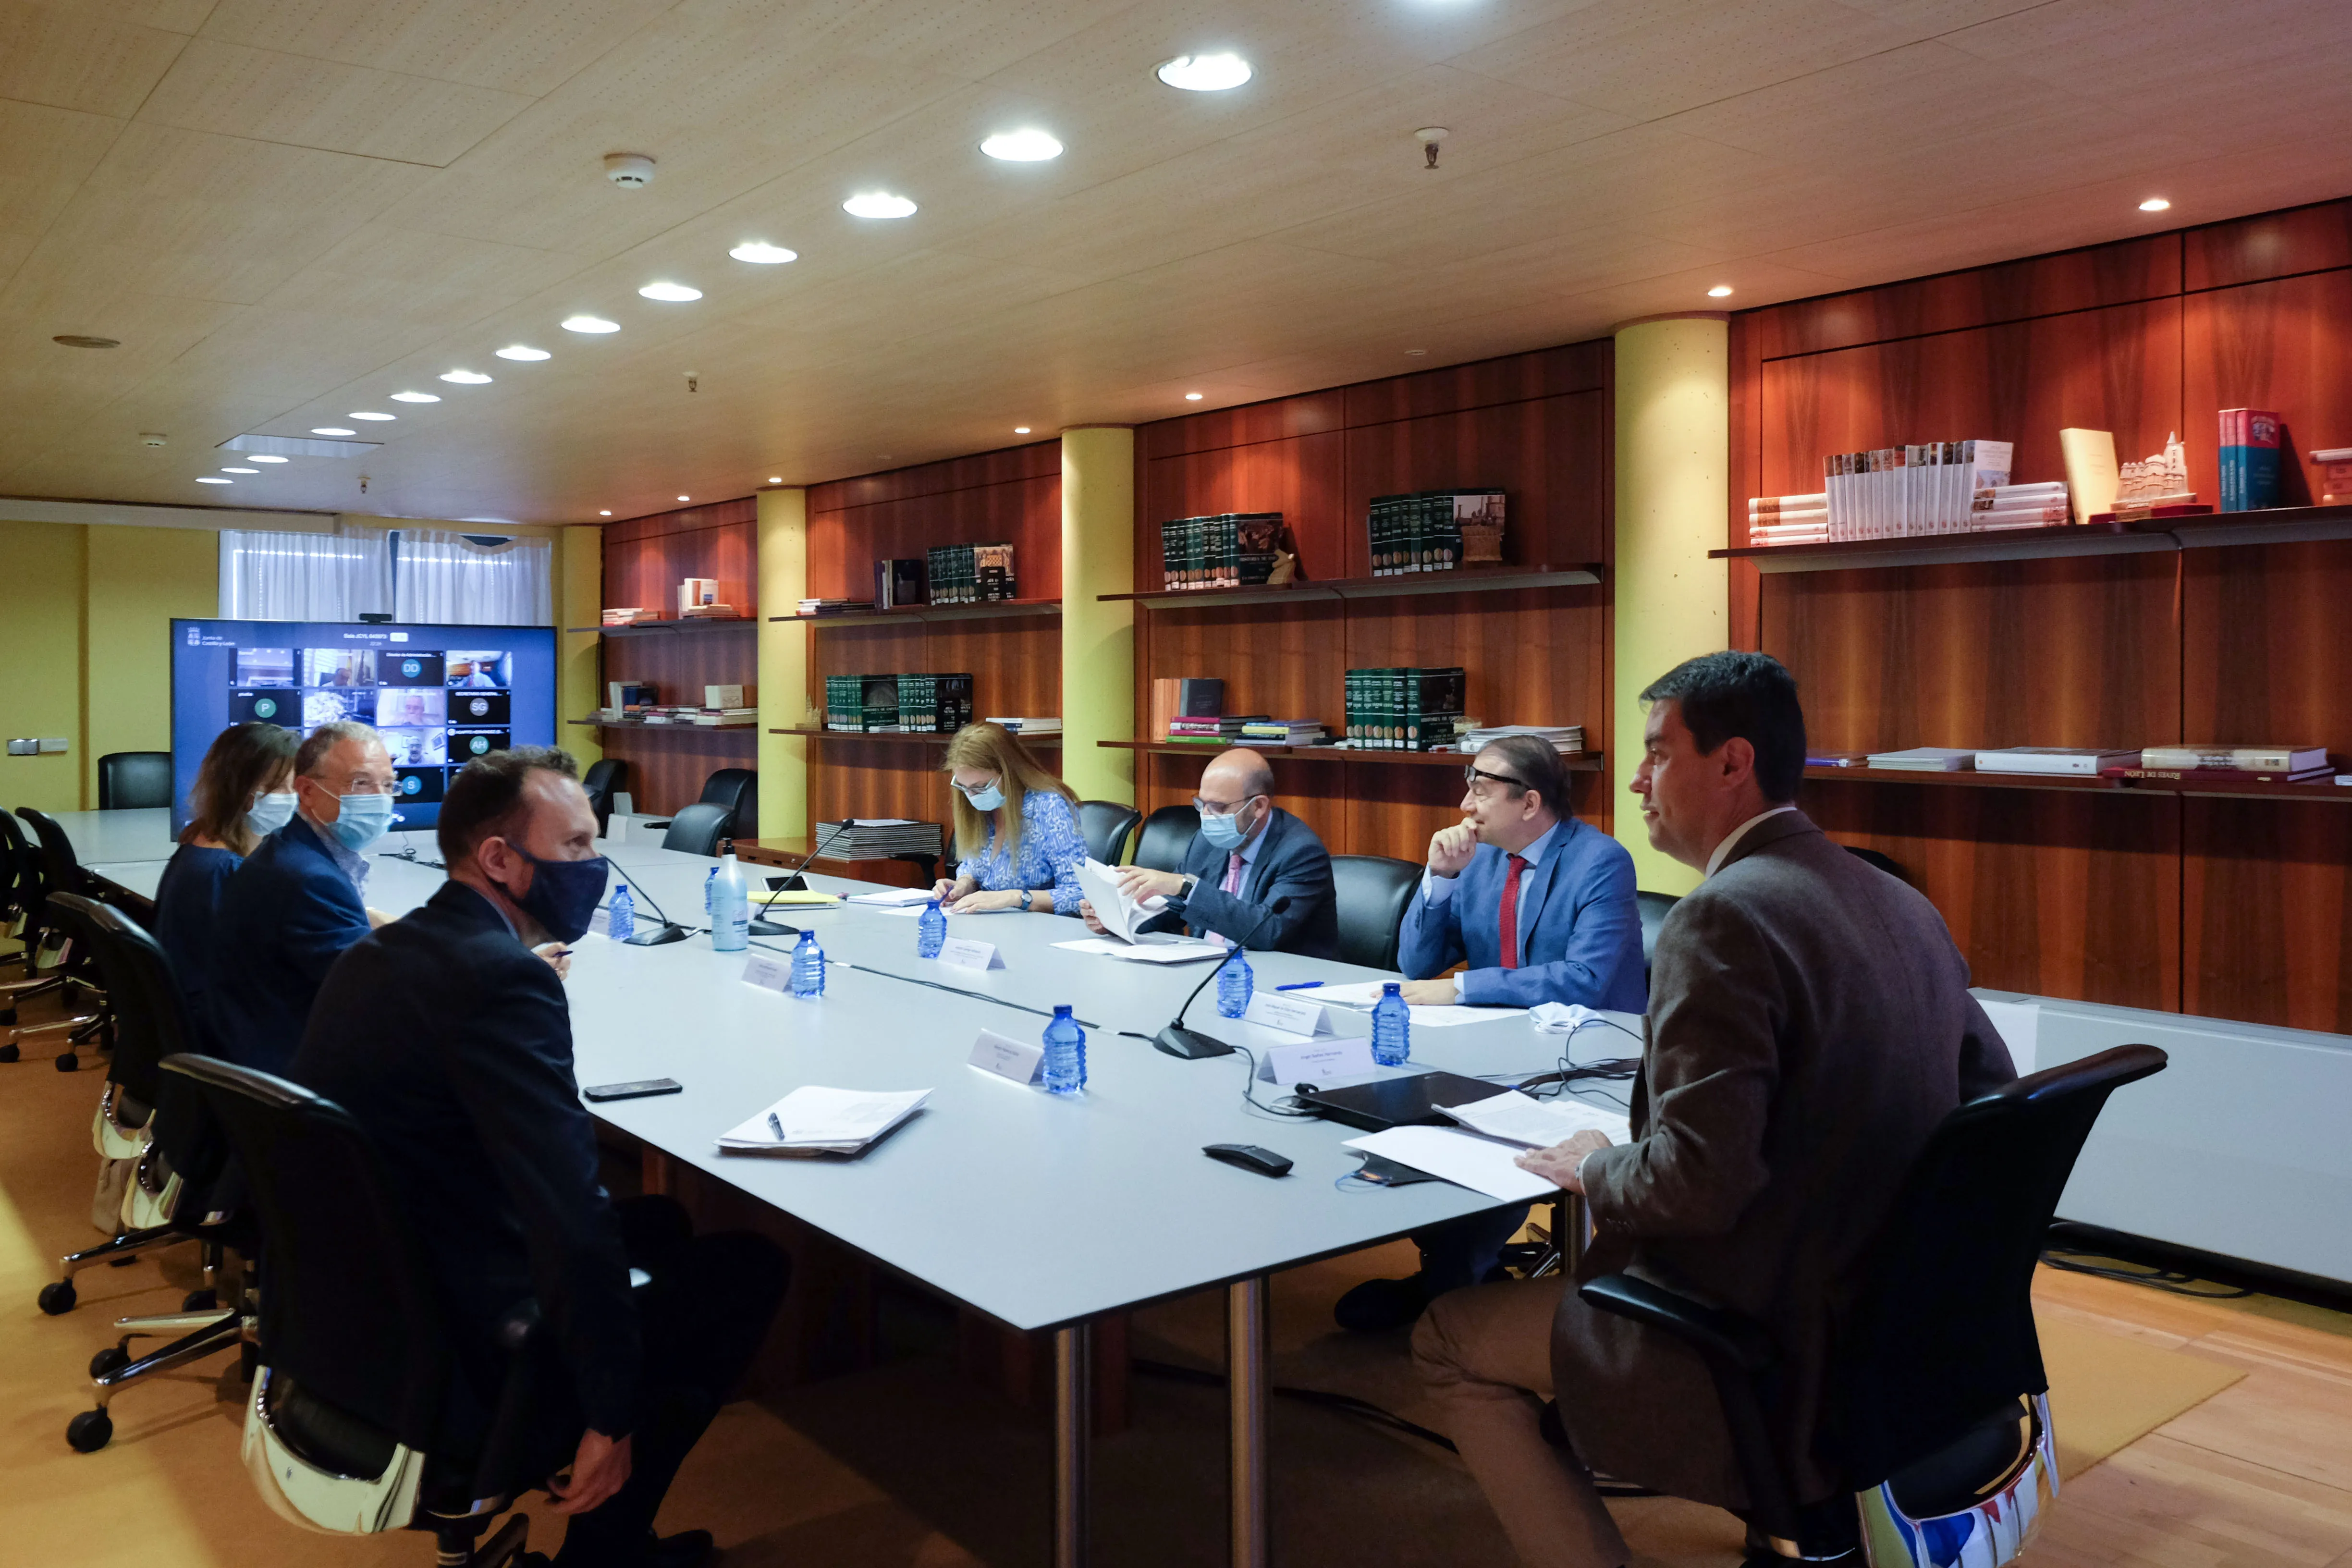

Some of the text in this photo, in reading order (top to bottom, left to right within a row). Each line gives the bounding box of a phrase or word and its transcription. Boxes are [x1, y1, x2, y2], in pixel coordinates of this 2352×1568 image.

[403, 664, 419, 673] DD
[261, 703, 270, 712] P
[471, 702, 487, 711] SG
[471, 741, 487, 749] AH
[407, 780, 416, 789] S
